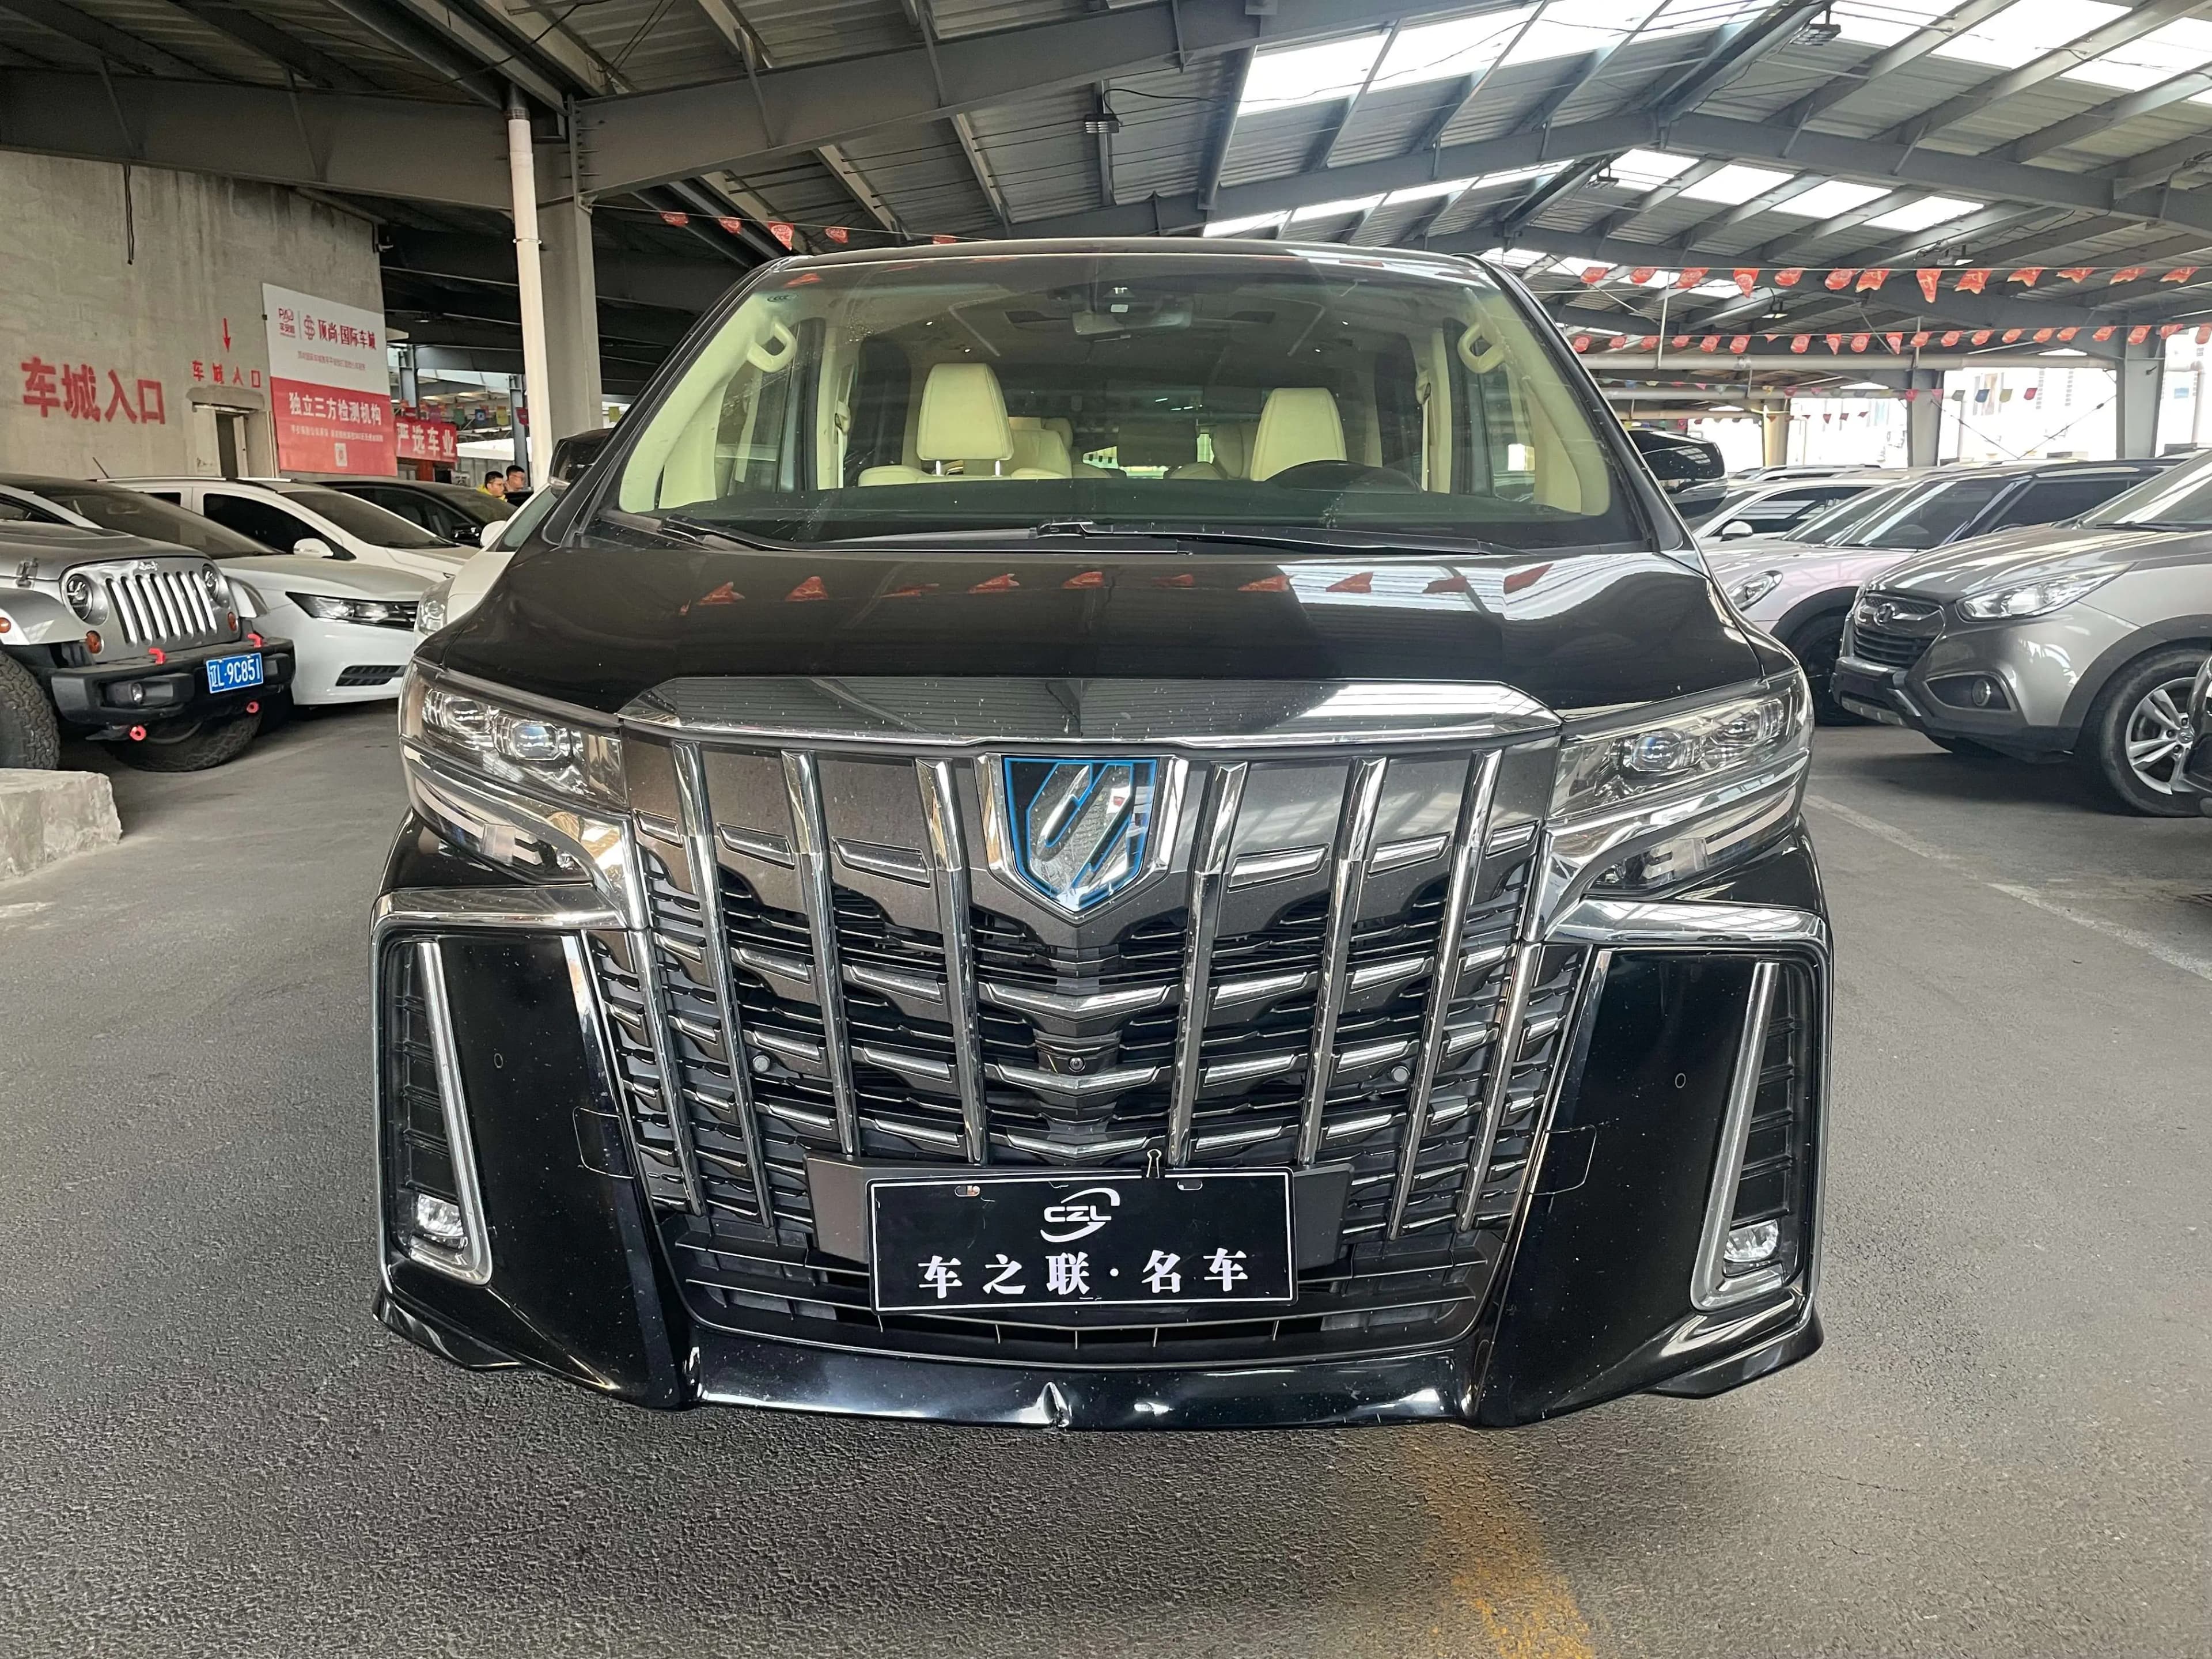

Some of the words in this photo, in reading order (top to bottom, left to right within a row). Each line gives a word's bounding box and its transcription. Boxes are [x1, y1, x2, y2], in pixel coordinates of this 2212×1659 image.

[21, 357, 165, 425] 车城入口
[192, 360, 260, 388] 车城入口
[289, 392, 381, 426] 独立三方检测机构
[1044, 1205, 1112, 1222] CZL
[918, 1248, 1248, 1299] 车之联·名车
